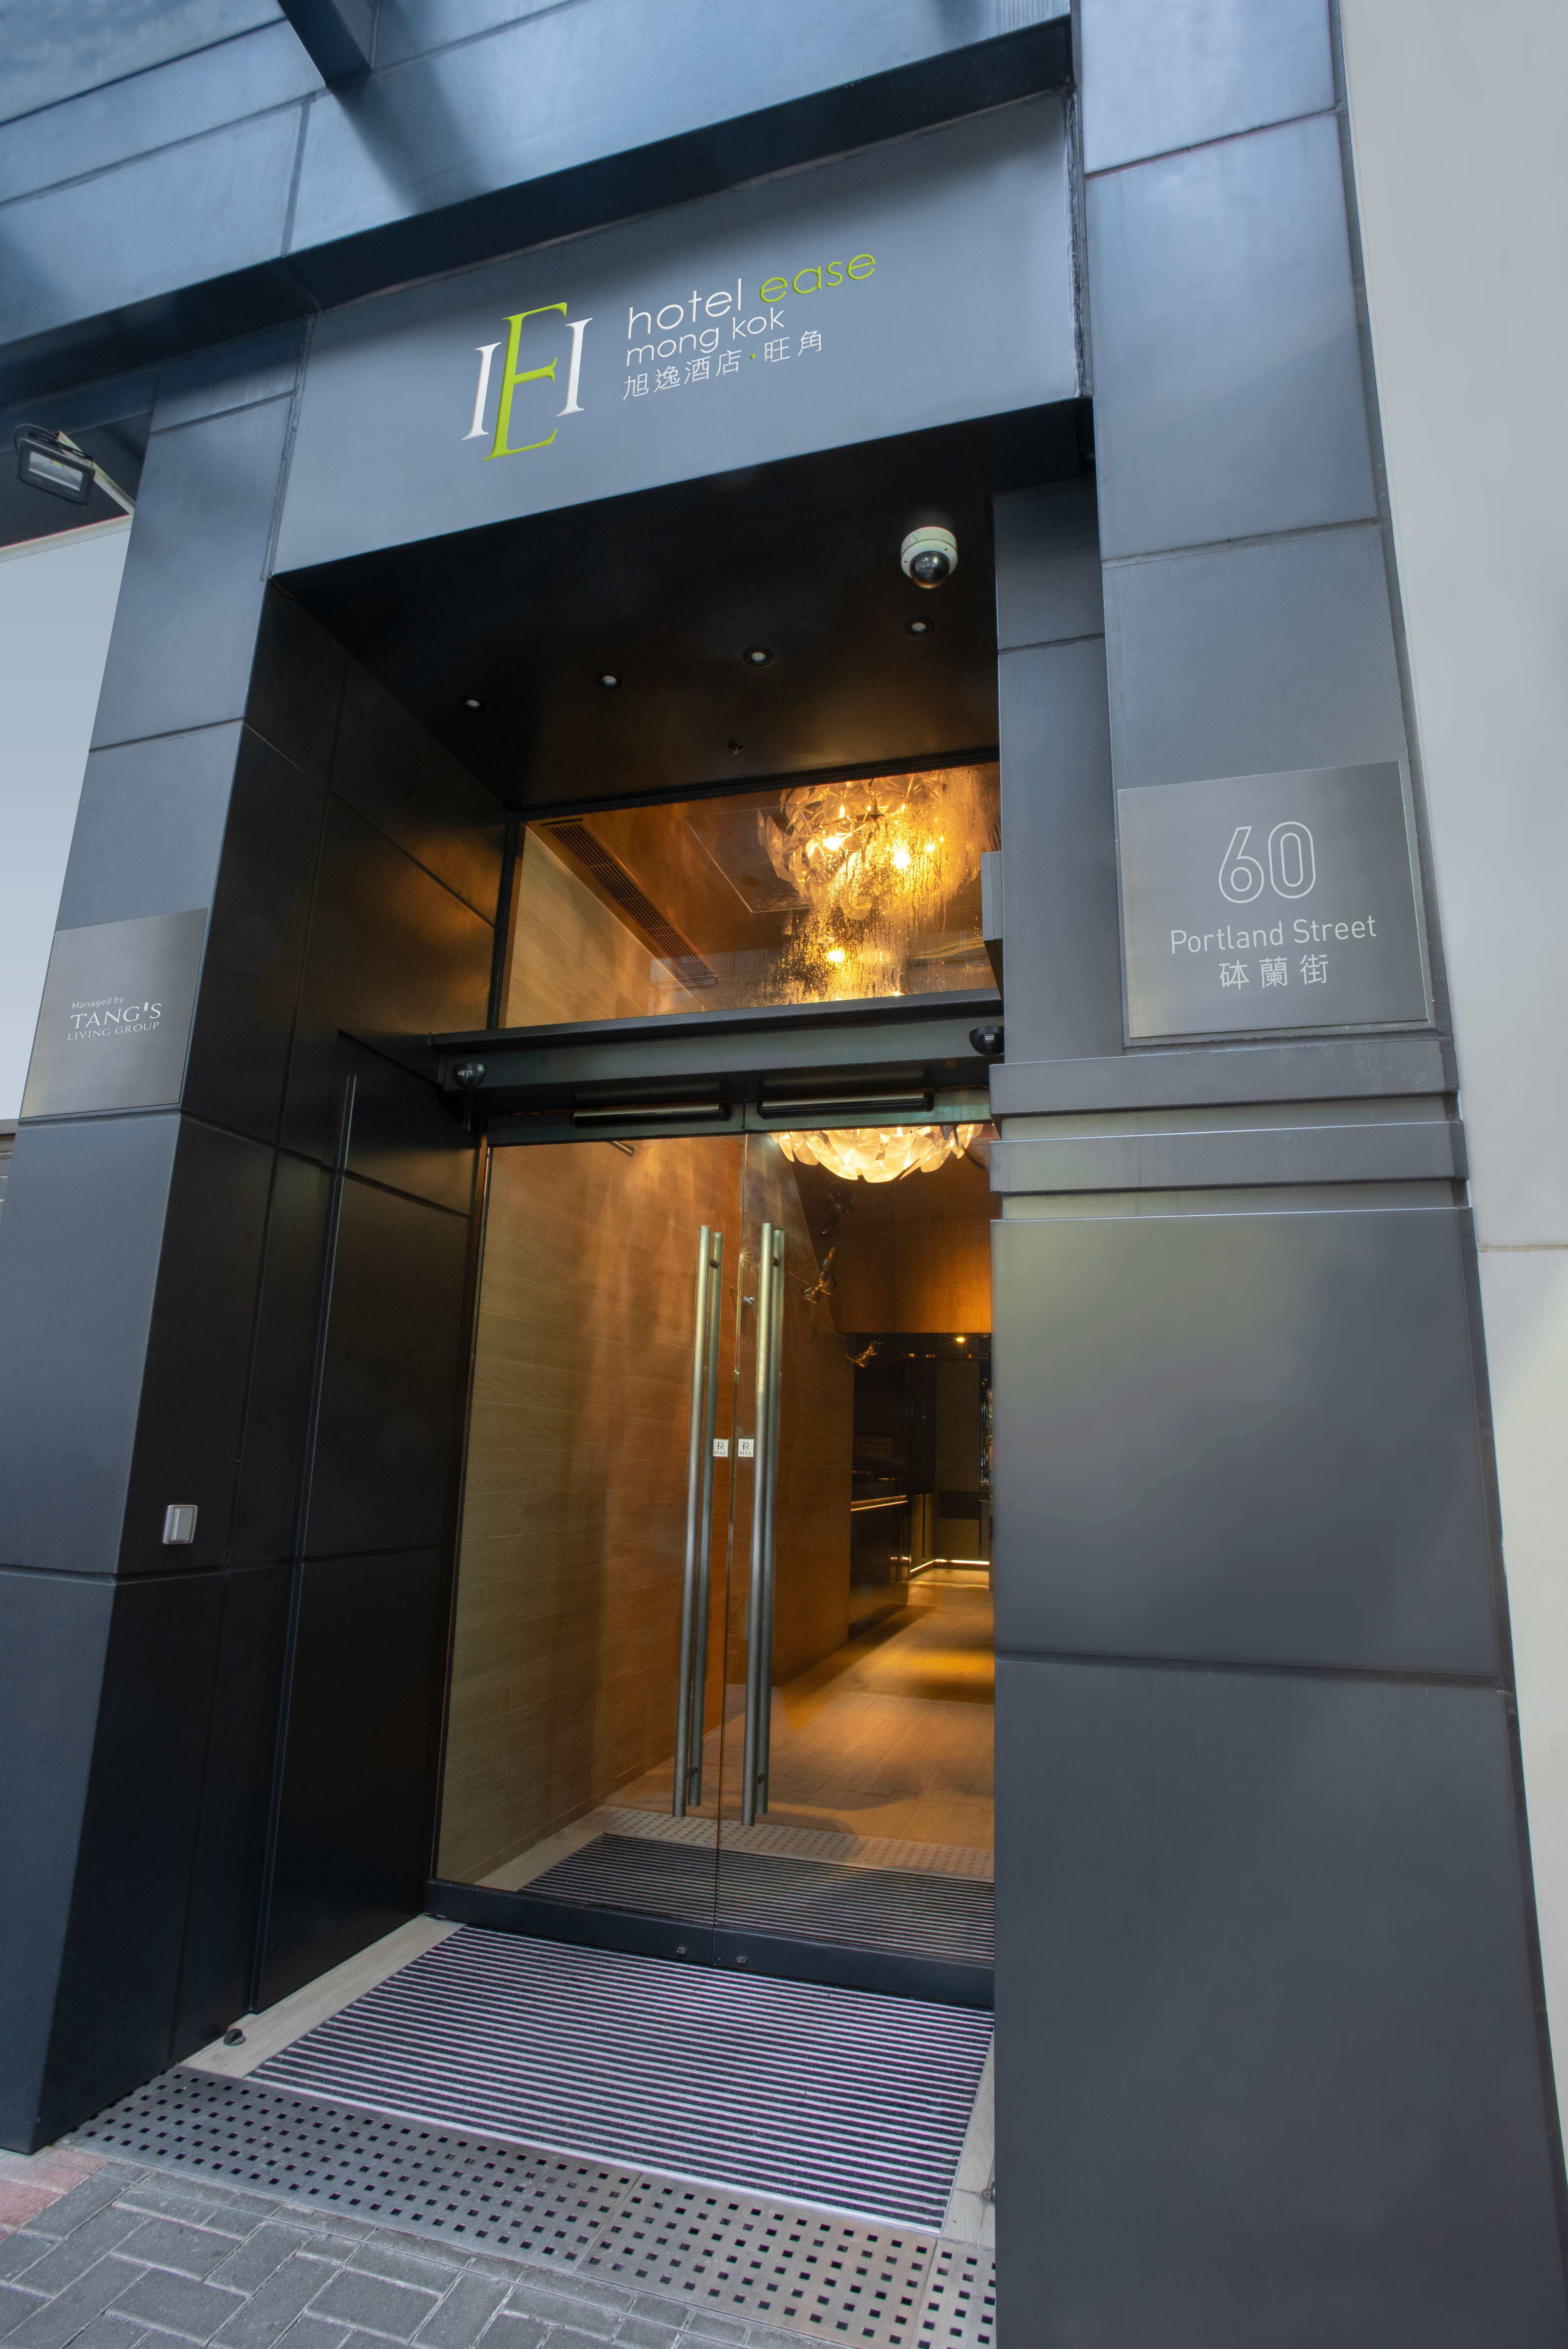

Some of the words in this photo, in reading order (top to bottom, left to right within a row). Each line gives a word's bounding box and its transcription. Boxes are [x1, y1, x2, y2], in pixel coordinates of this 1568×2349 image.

[627, 278, 743, 339] hotel
[759, 253, 876, 303] ease
[626, 326, 720, 367] mong
[732, 307, 785, 340] kok
[1218, 821, 1316, 904] 60
[1171, 920, 1284, 954] Portland
[1293, 915, 1377, 943] Street
[1219, 954, 1329, 990] 砵蘭街
[70, 1002, 162, 1029] TANG'S
[72, 997, 112, 1009] Managed
[114, 996, 124, 1005] by
[68, 1028, 111, 1041] LIVING
[115, 1021, 160, 1034] GROUP
[717, 1441, 725, 1450] 拉
[742, 1441, 750, 1450] 拉
